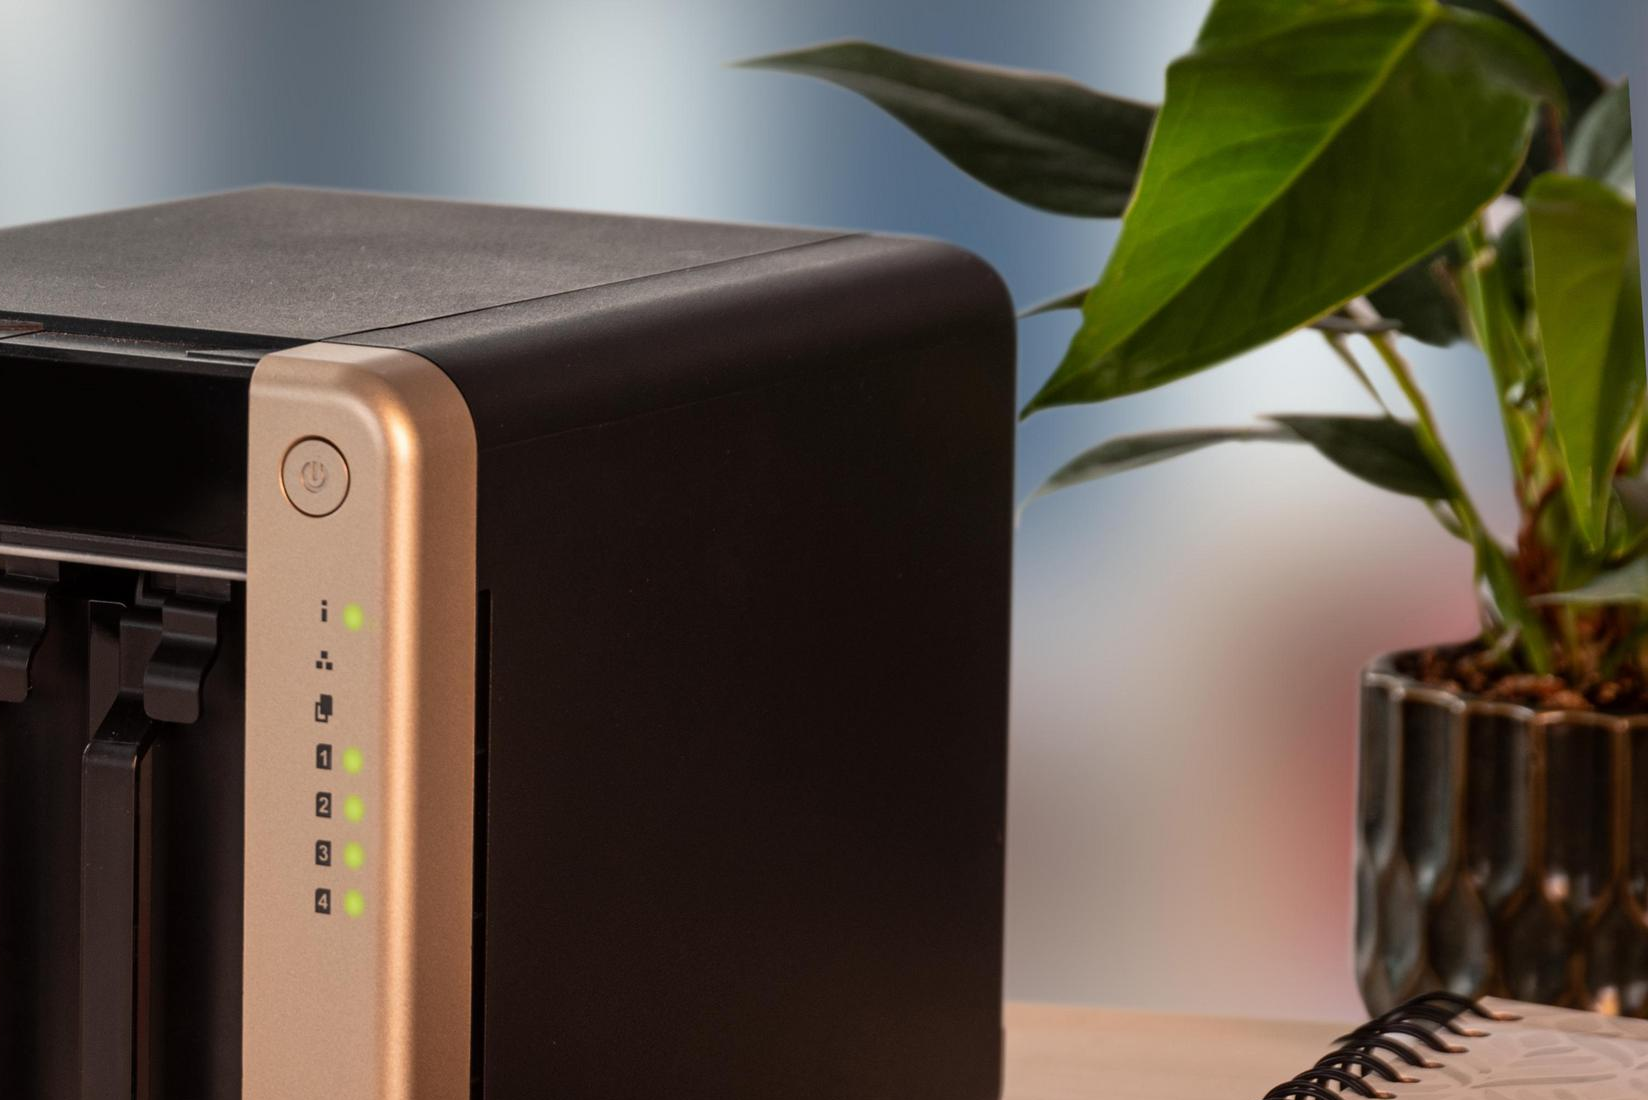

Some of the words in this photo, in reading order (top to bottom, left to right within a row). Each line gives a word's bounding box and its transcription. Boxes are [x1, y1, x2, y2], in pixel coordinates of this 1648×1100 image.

[318, 796, 330, 814] 2
[318, 844, 329, 862] 3
[317, 893, 329, 910] 4
